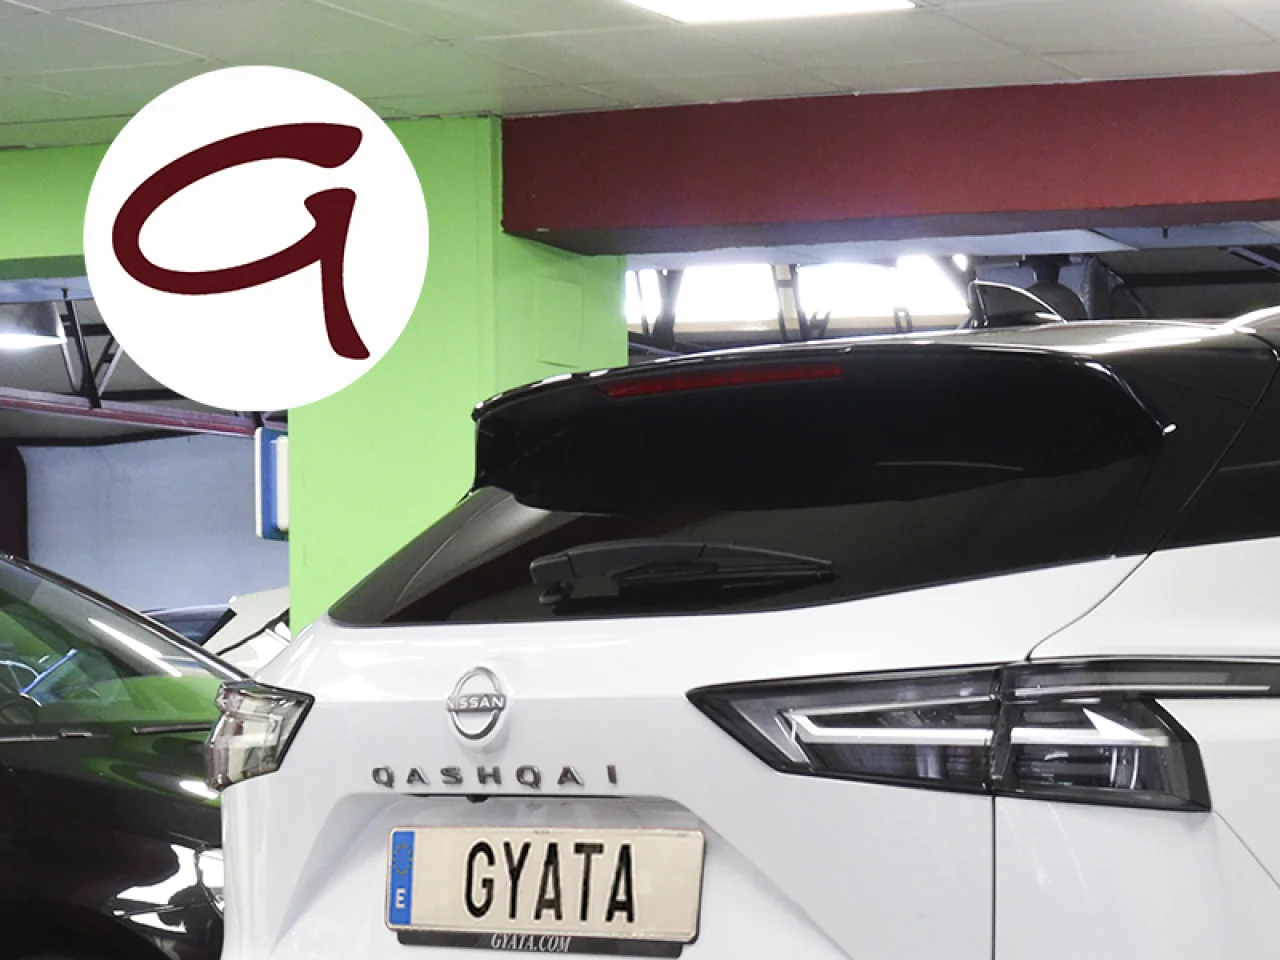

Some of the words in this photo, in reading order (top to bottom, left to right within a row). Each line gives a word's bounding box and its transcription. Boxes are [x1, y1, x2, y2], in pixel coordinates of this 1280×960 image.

[447, 696, 504, 709] NISSAN
[371, 765, 618, 788] QASHQAI
[465, 841, 635, 923] GYATA
[395, 888, 406, 909] E
[490, 933, 572, 953] GYATA.COM
